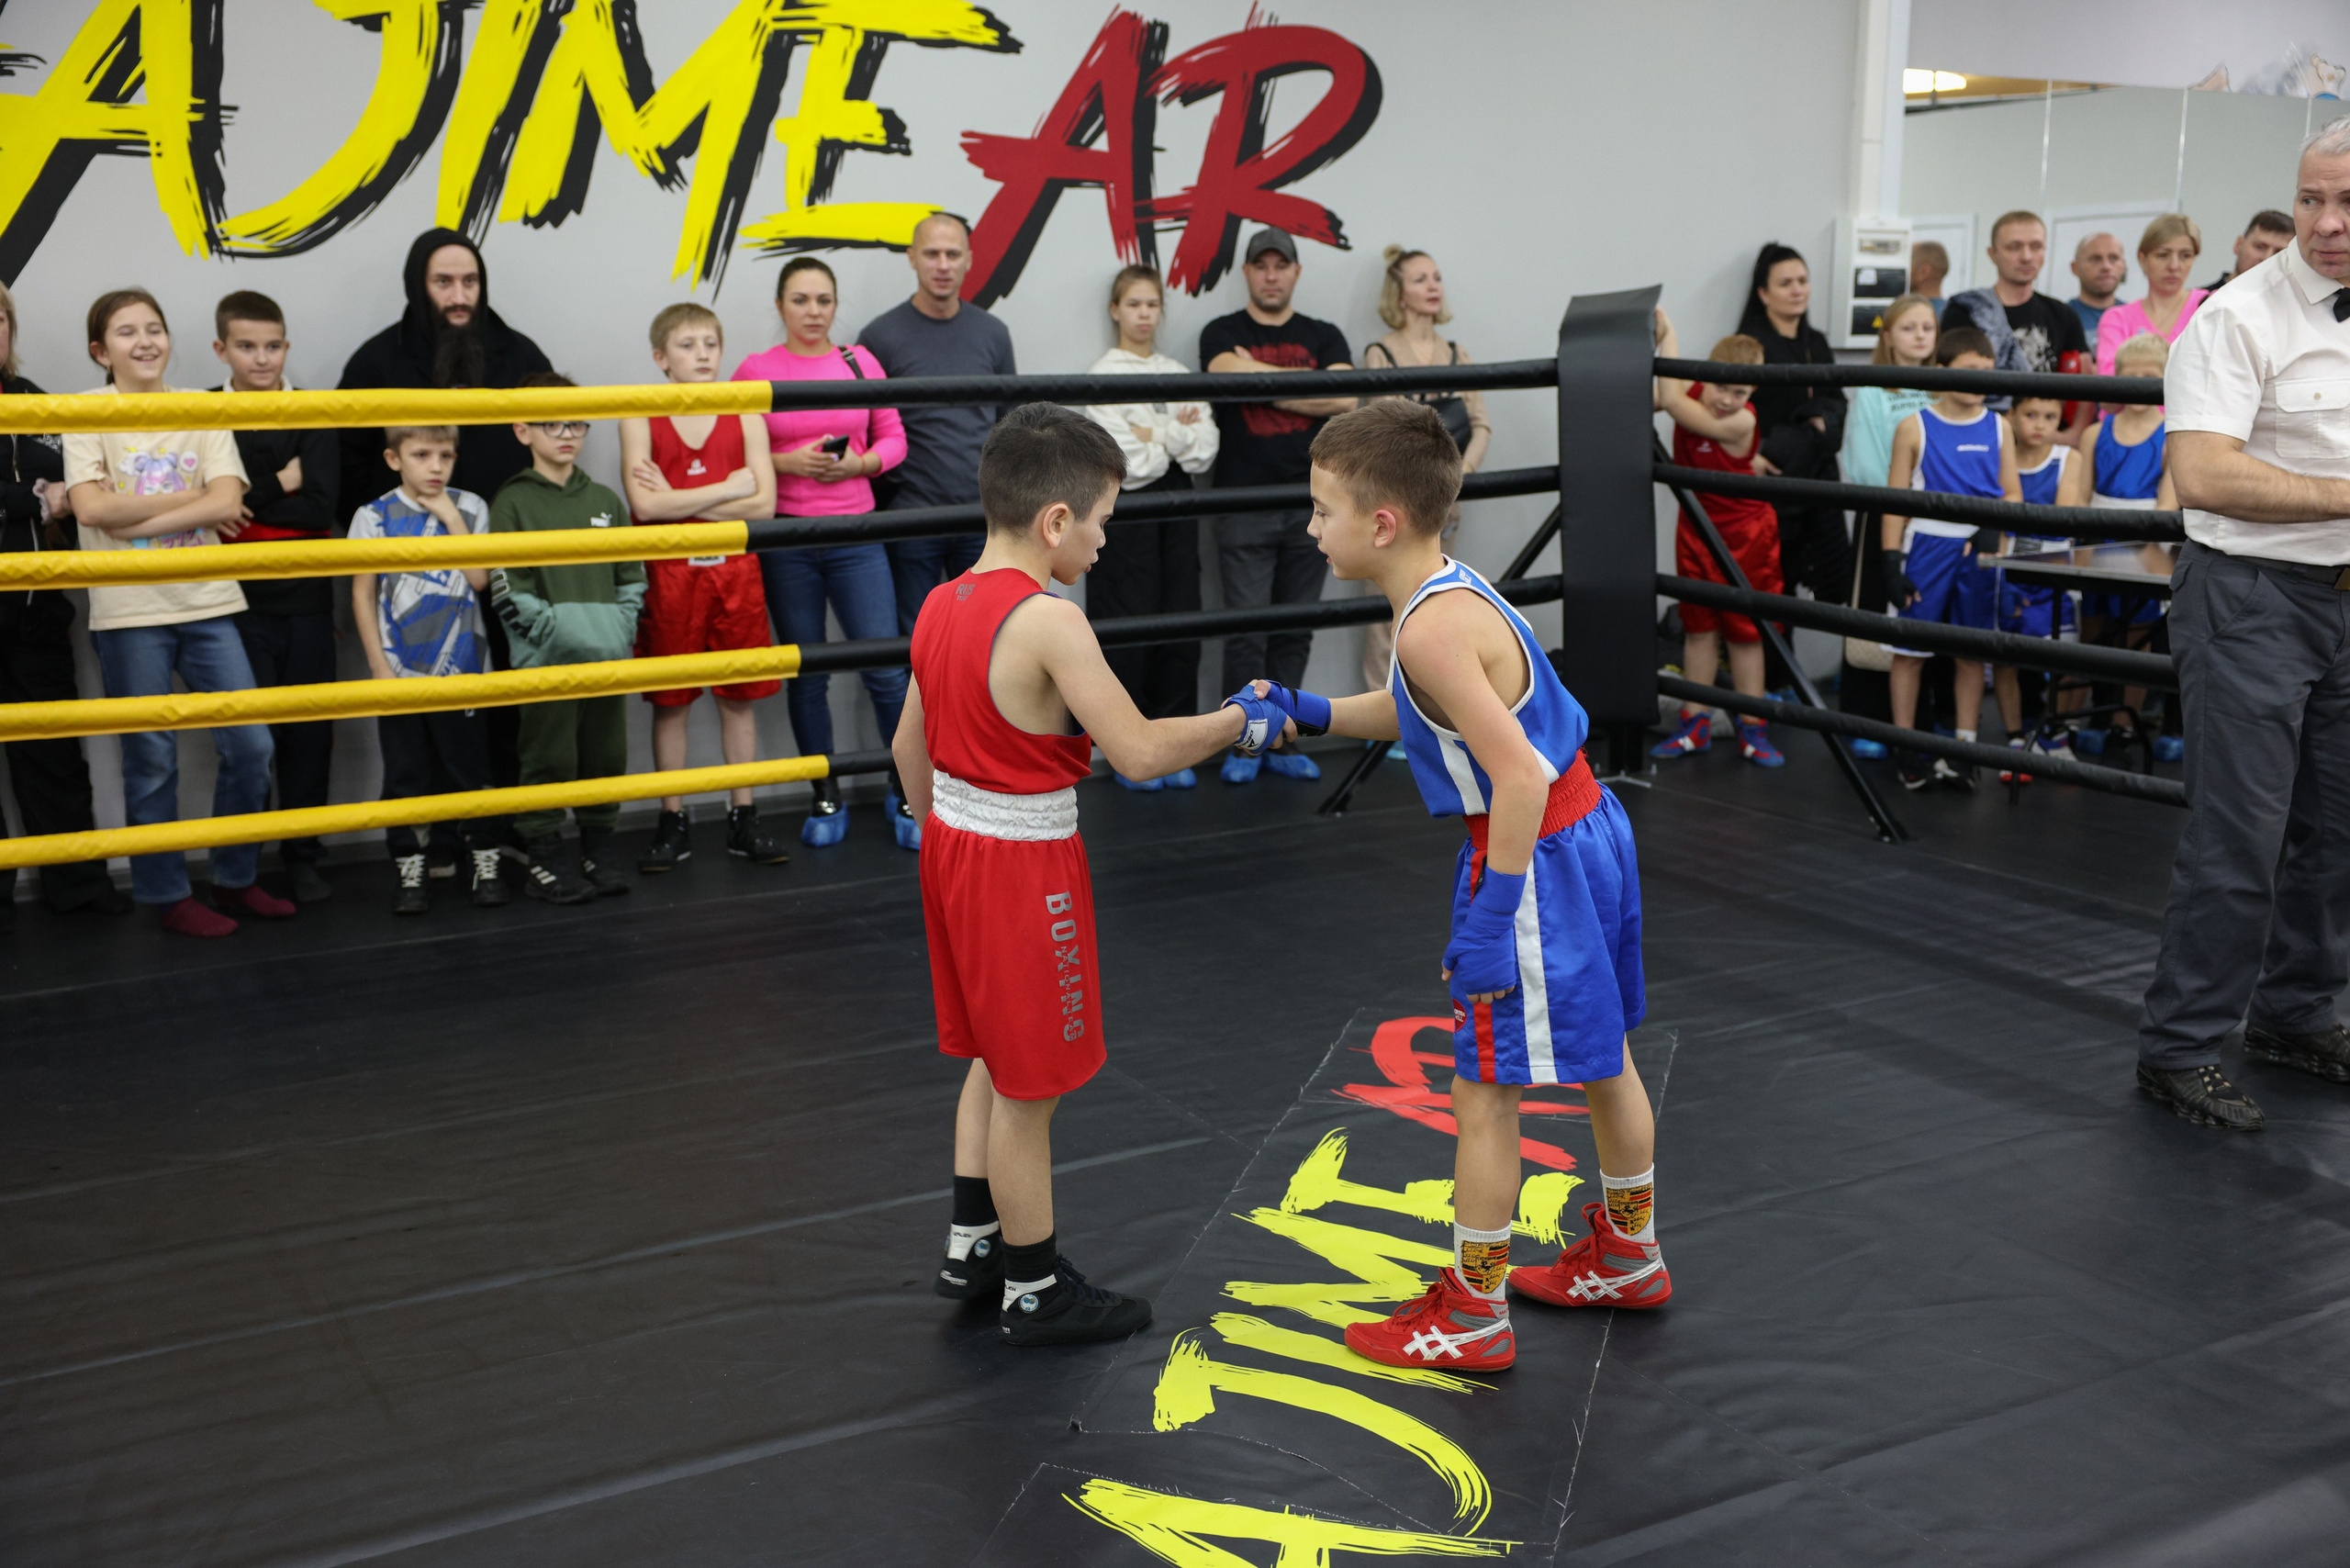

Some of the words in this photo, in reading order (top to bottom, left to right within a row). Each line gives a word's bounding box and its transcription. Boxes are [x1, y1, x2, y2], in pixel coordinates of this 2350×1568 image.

[0, 0, 1023, 303] AJIME
[958, 0, 1382, 309] AR
[956, 584, 976, 595] RUS
[1046, 891, 1084, 1042] BOXING
[1060, 946, 1073, 1009] NATIONAL
[1068, 1011, 1078, 1041] TEAM
